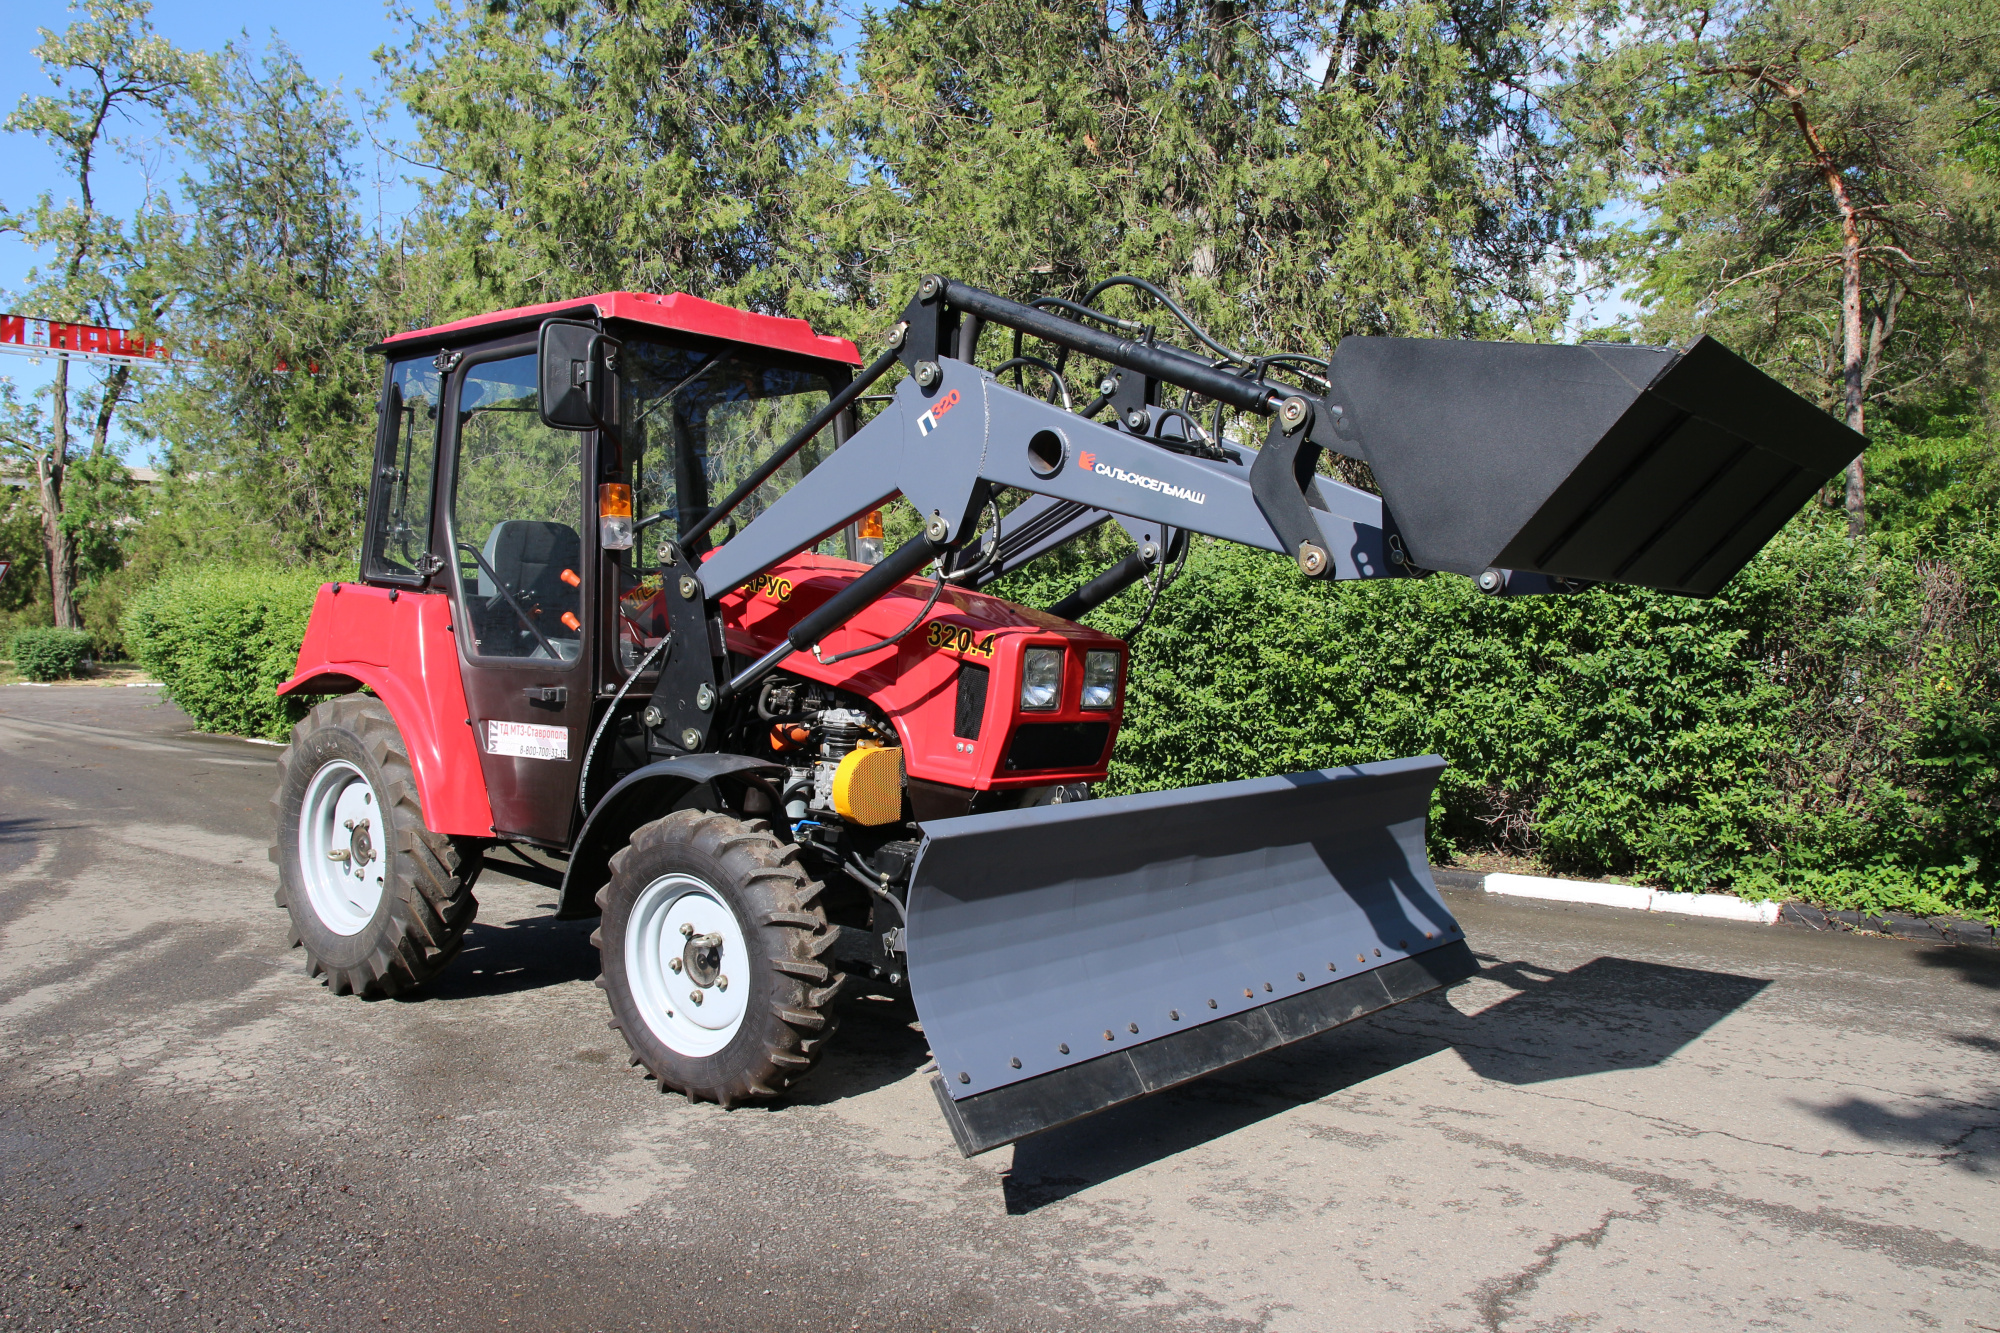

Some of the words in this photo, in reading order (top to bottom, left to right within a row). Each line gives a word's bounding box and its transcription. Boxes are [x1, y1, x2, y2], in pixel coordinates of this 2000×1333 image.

[1094, 462, 1206, 505] САЛЬСКСЕЛЬМАШ
[926, 620, 996, 660] 320.4
[500, 723, 509, 736] ТД
